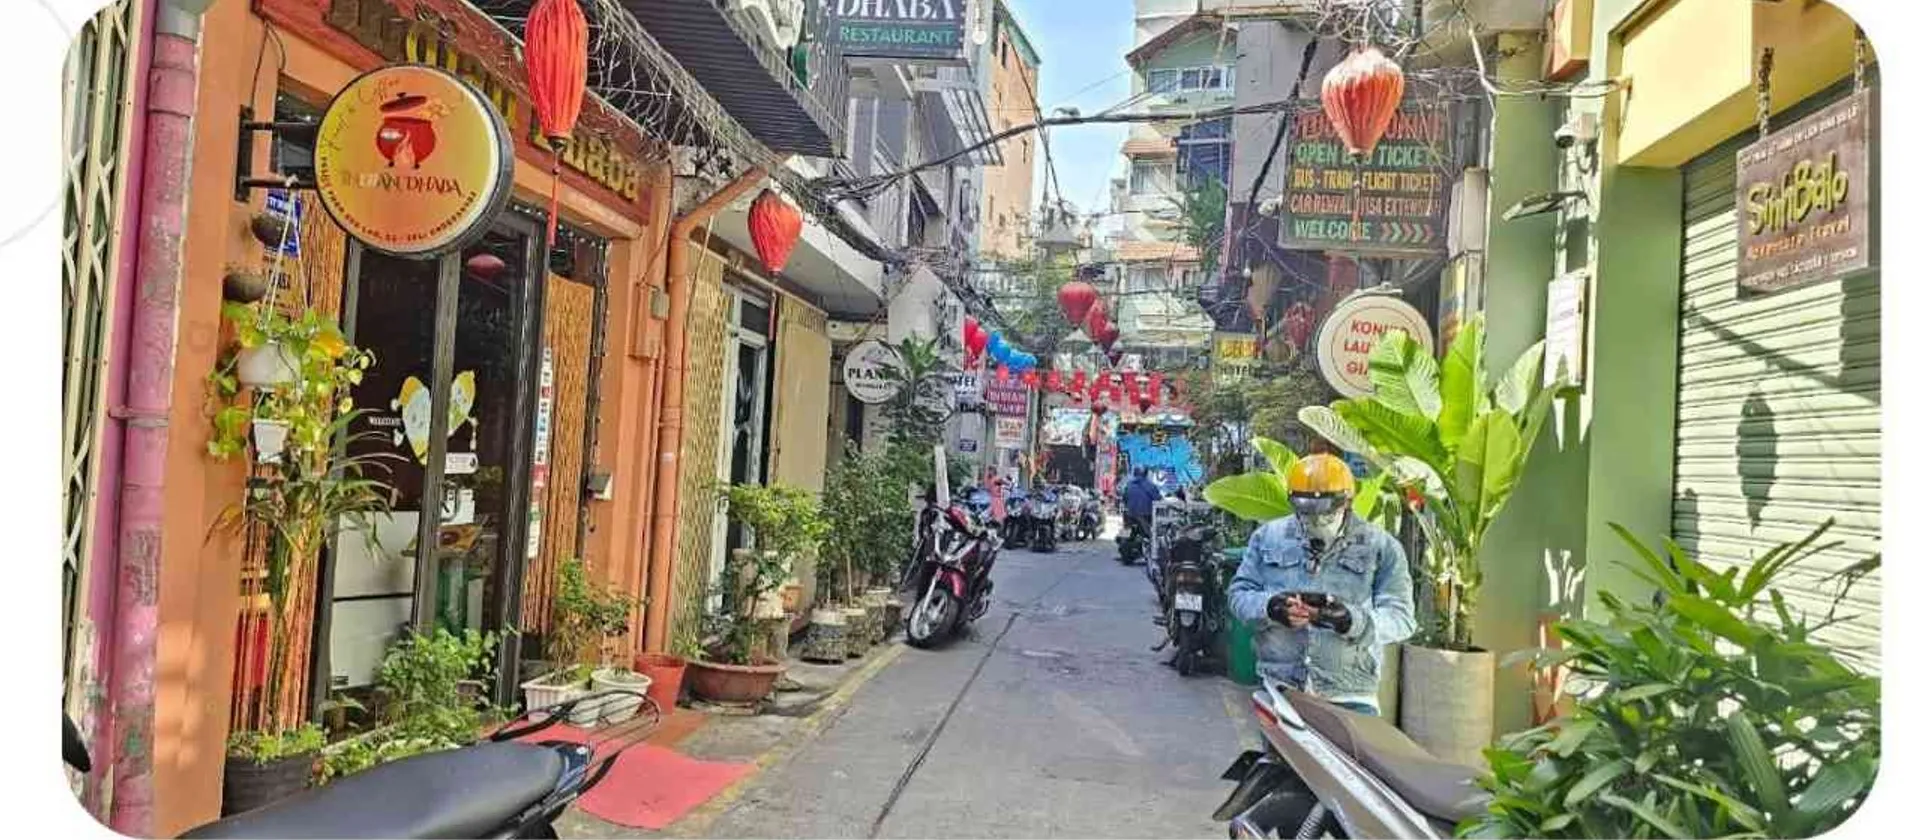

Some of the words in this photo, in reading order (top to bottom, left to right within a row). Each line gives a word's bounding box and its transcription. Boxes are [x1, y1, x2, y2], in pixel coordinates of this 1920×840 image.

[837, 0, 955, 18] DHABA
[840, 26, 954, 44] RESTAURANT
[1297, 143, 1338, 164] OPEN
[407, 174, 465, 198] DHABA
[1294, 168, 1315, 189] BUS
[1362, 171, 1397, 191] FLIGHT
[1290, 193, 1312, 213] CAR
[1314, 193, 1351, 214] RENTAL
